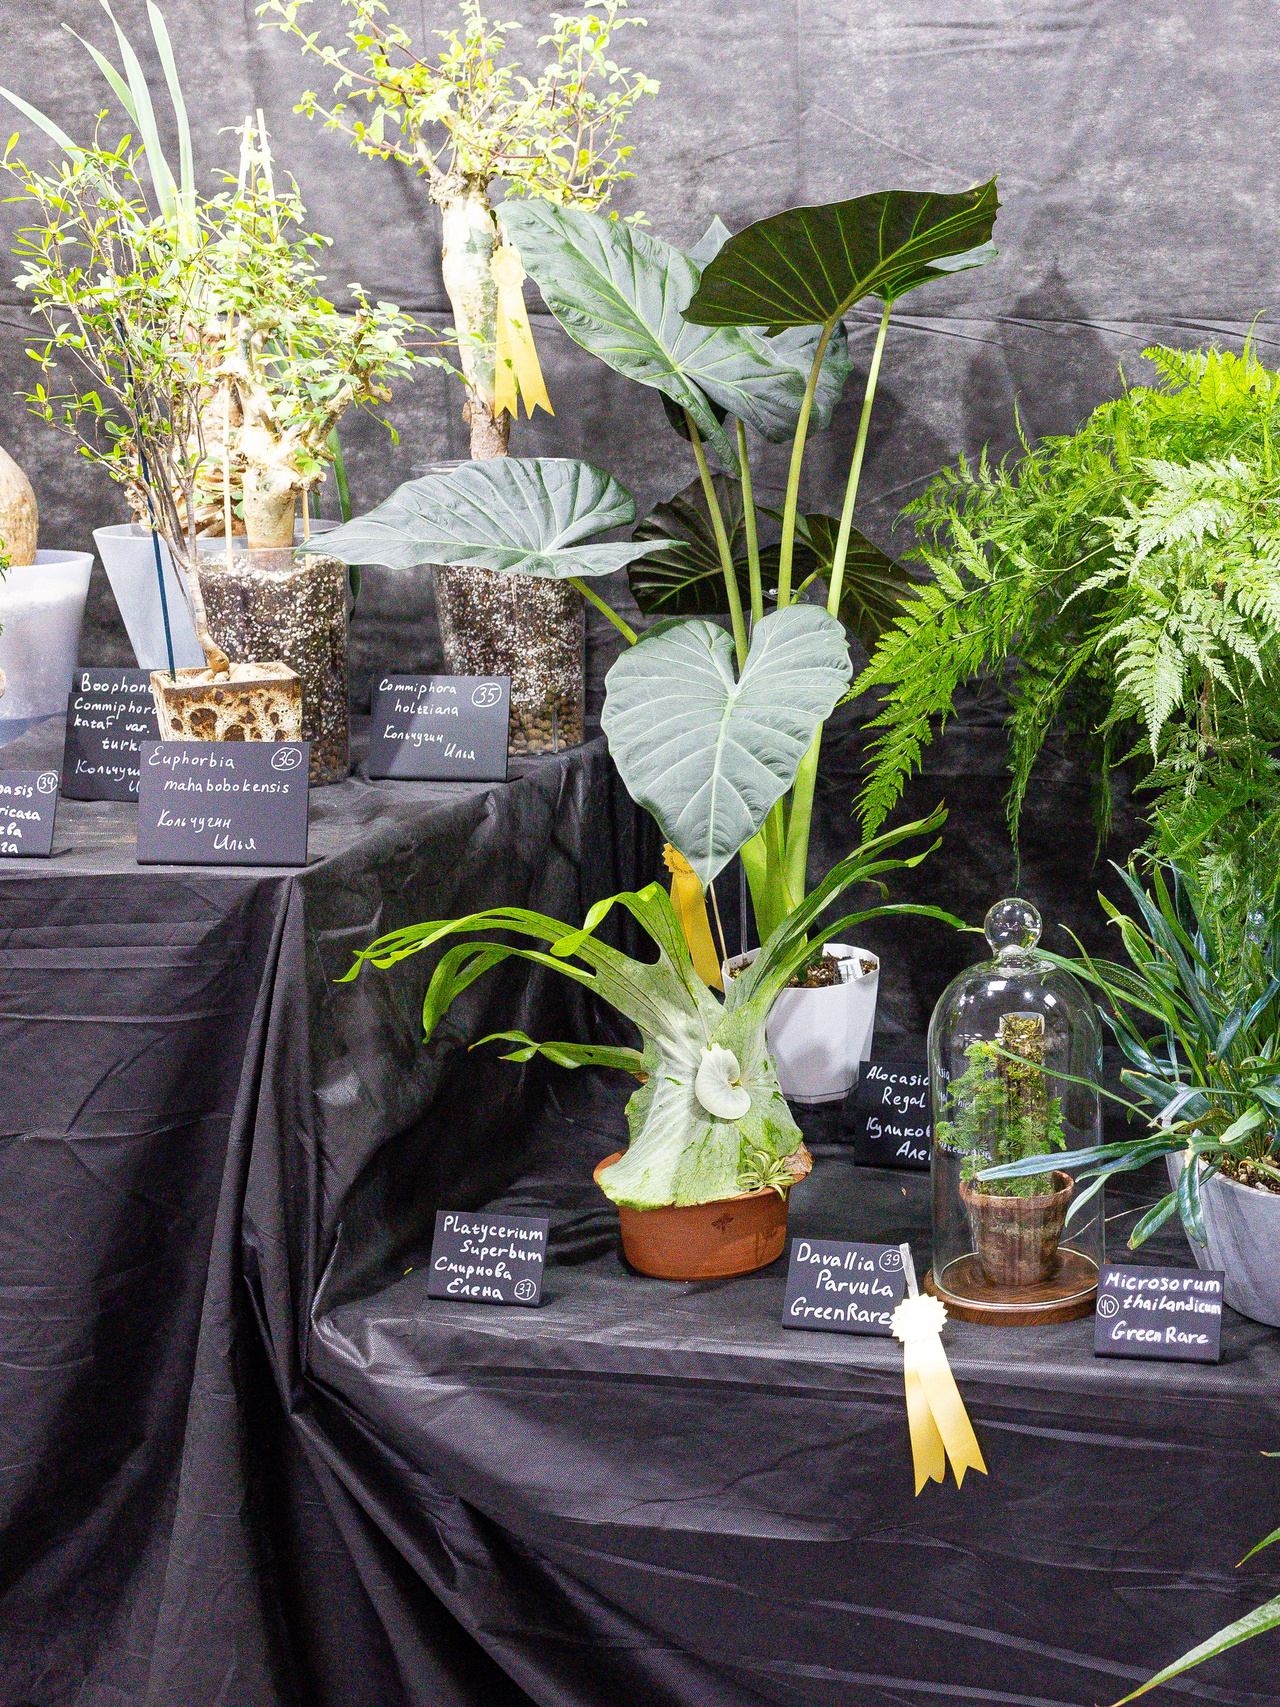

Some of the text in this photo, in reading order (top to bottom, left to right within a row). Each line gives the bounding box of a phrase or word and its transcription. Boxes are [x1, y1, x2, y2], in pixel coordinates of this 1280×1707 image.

[379, 679, 499, 704] Commiphora 35
[125, 723, 150, 734] var.
[383, 724, 444, 747] Кольчугин
[102, 737, 141, 752] turk
[443, 742, 476, 760] Илья
[148, 745, 296, 771] Euphorbia 36
[157, 809, 232, 834] Кольчугин
[213, 833, 257, 851] Илья
[881, 1085, 926, 1114] Regal
[895, 1140, 931, 1161] Але
[443, 1215, 543, 1243] Platycerium
[459, 1239, 543, 1263] Superbum
[796, 1242, 875, 1272] Davallia
[434, 1256, 513, 1280] Смирнова
[446, 1277, 532, 1301] Елена 37
[815, 1268, 894, 1298] Parvula
[1104, 1272, 1220, 1293] Microsorum
[1123, 1293, 1221, 1315] thailandicum
